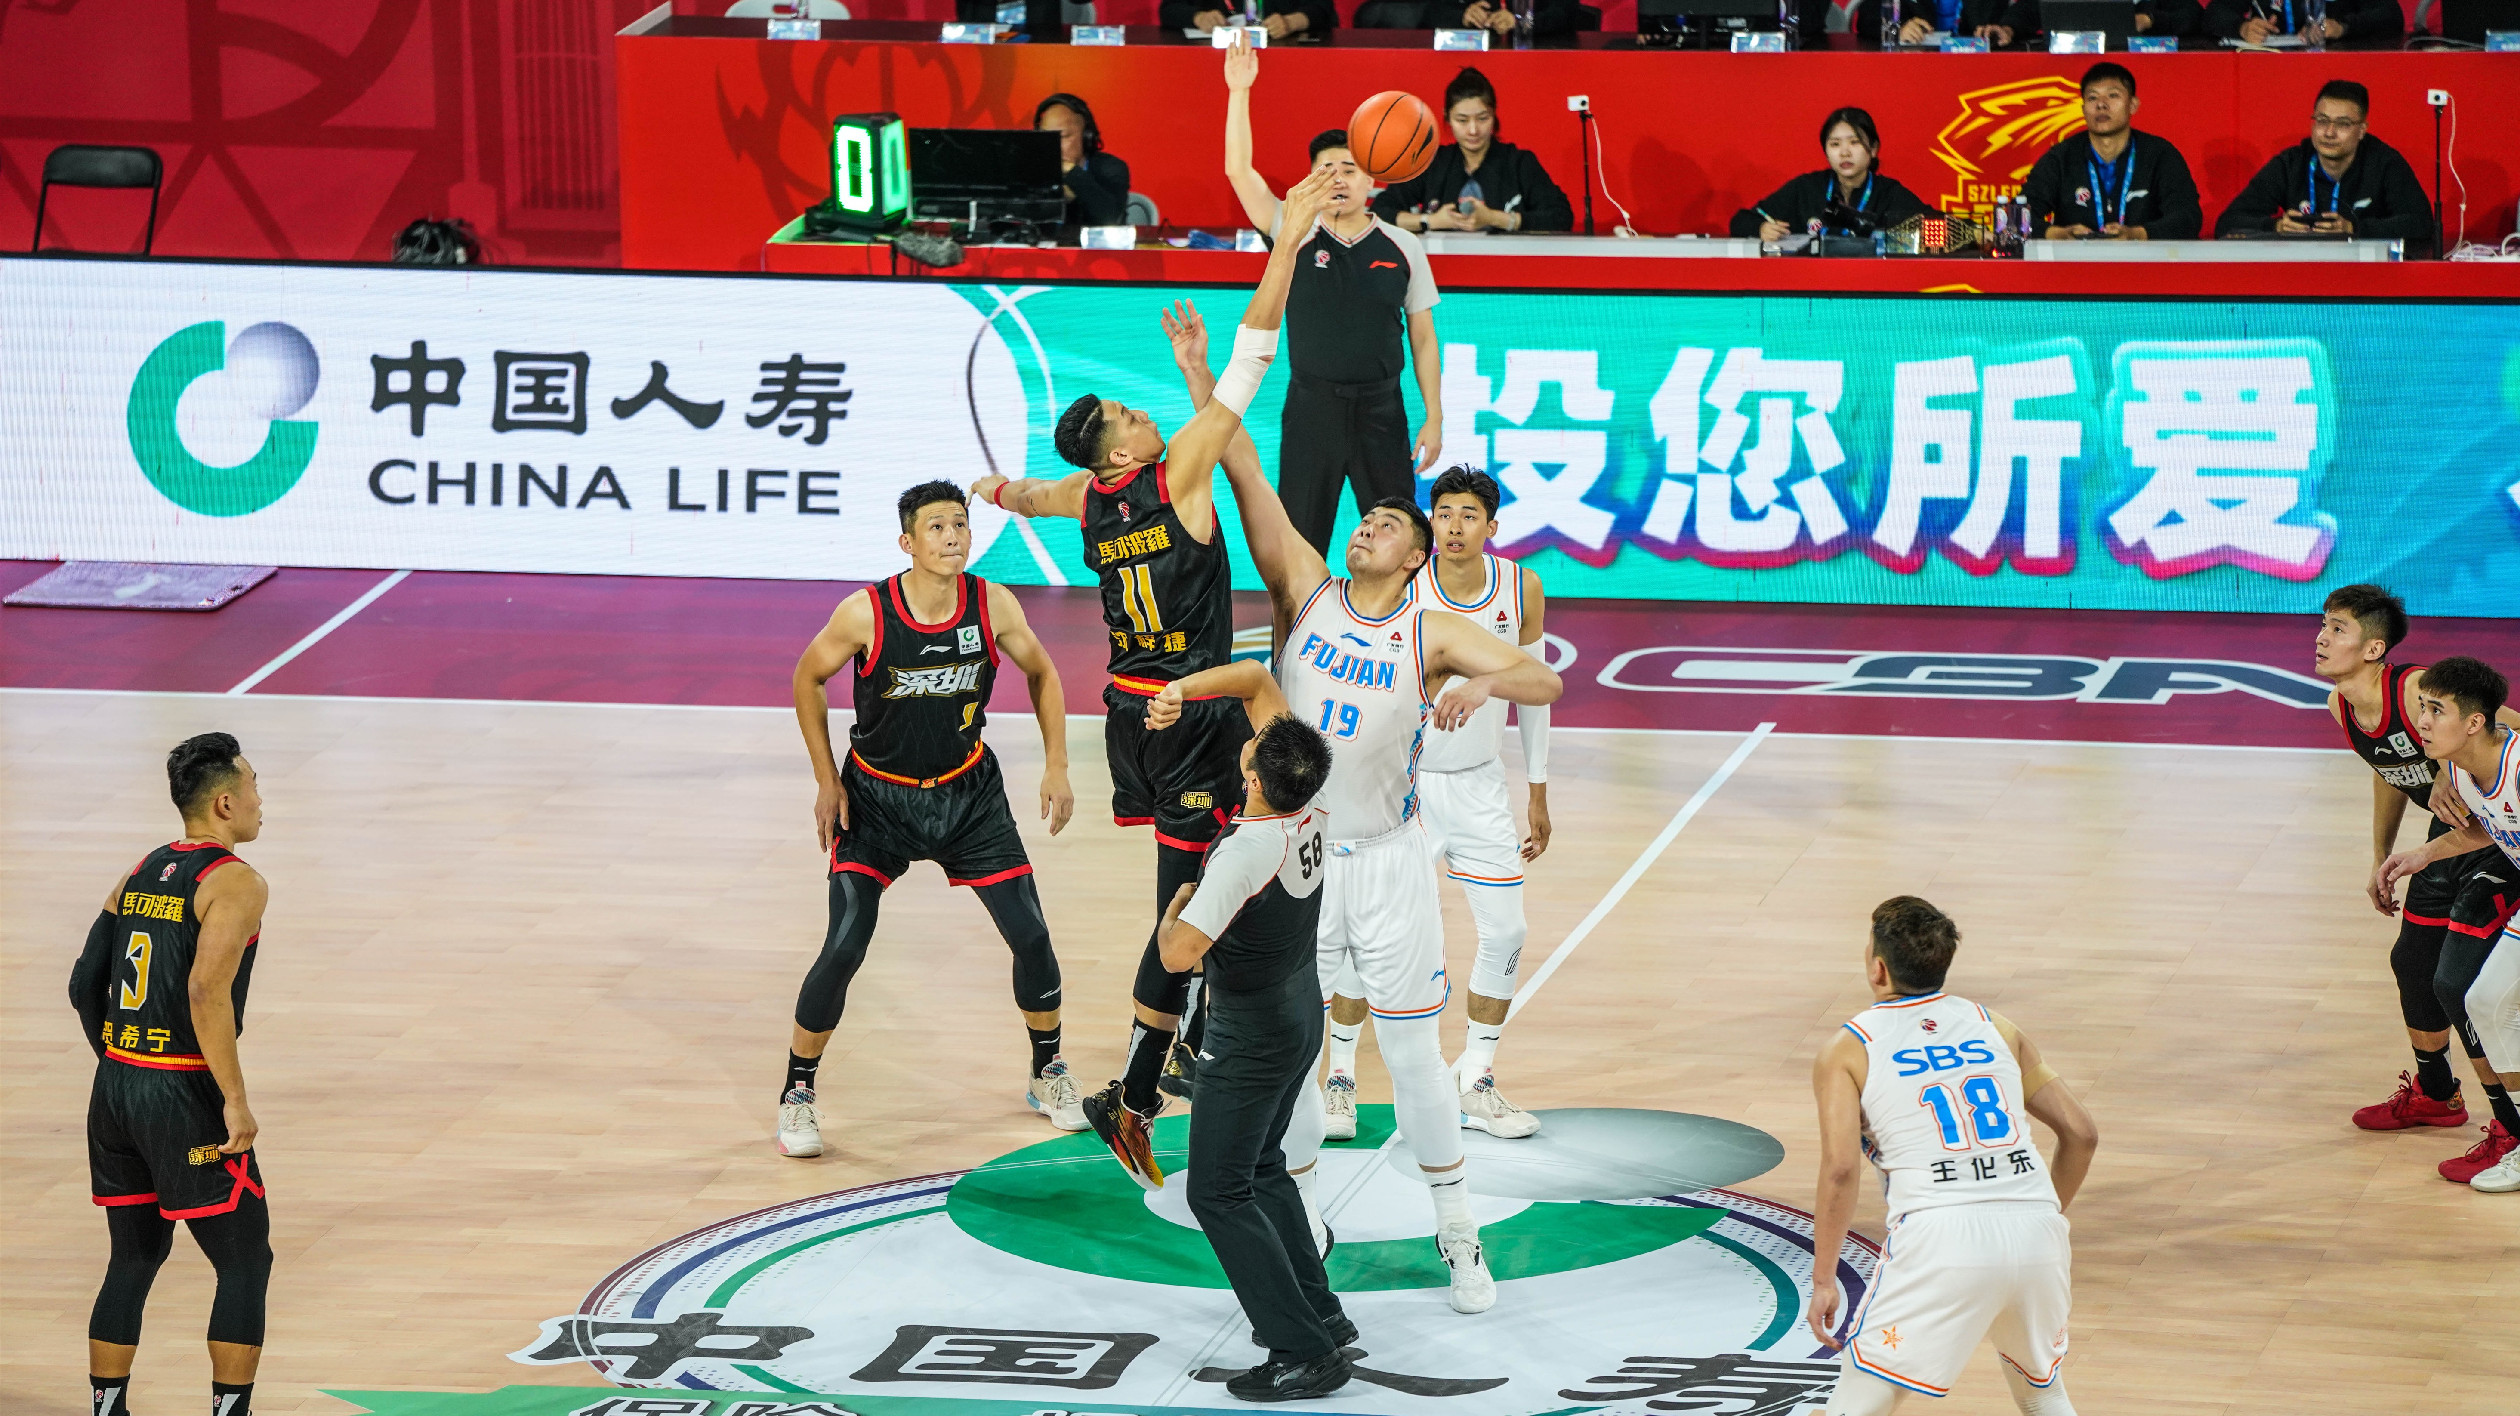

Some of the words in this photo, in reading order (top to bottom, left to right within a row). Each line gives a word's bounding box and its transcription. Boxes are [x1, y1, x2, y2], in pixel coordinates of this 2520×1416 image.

[370, 339, 854, 446] 中国人寿
[368, 458, 632, 511] CHINA
[668, 466, 841, 515] LIFE
[1421, 341, 2335, 570] 投您所爱
[1117, 563, 1164, 633] 11
[1299, 632, 1398, 693] FUJIAN
[1596, 645, 2332, 709] CBA
[1318, 698, 1363, 742] 19
[1298, 831, 1323, 880] 58
[122, 891, 185, 923] 馬可波羅
[120, 930, 152, 1011] 3
[1892, 1039, 1995, 1078] SBS
[1919, 1075, 2020, 1151] 18
